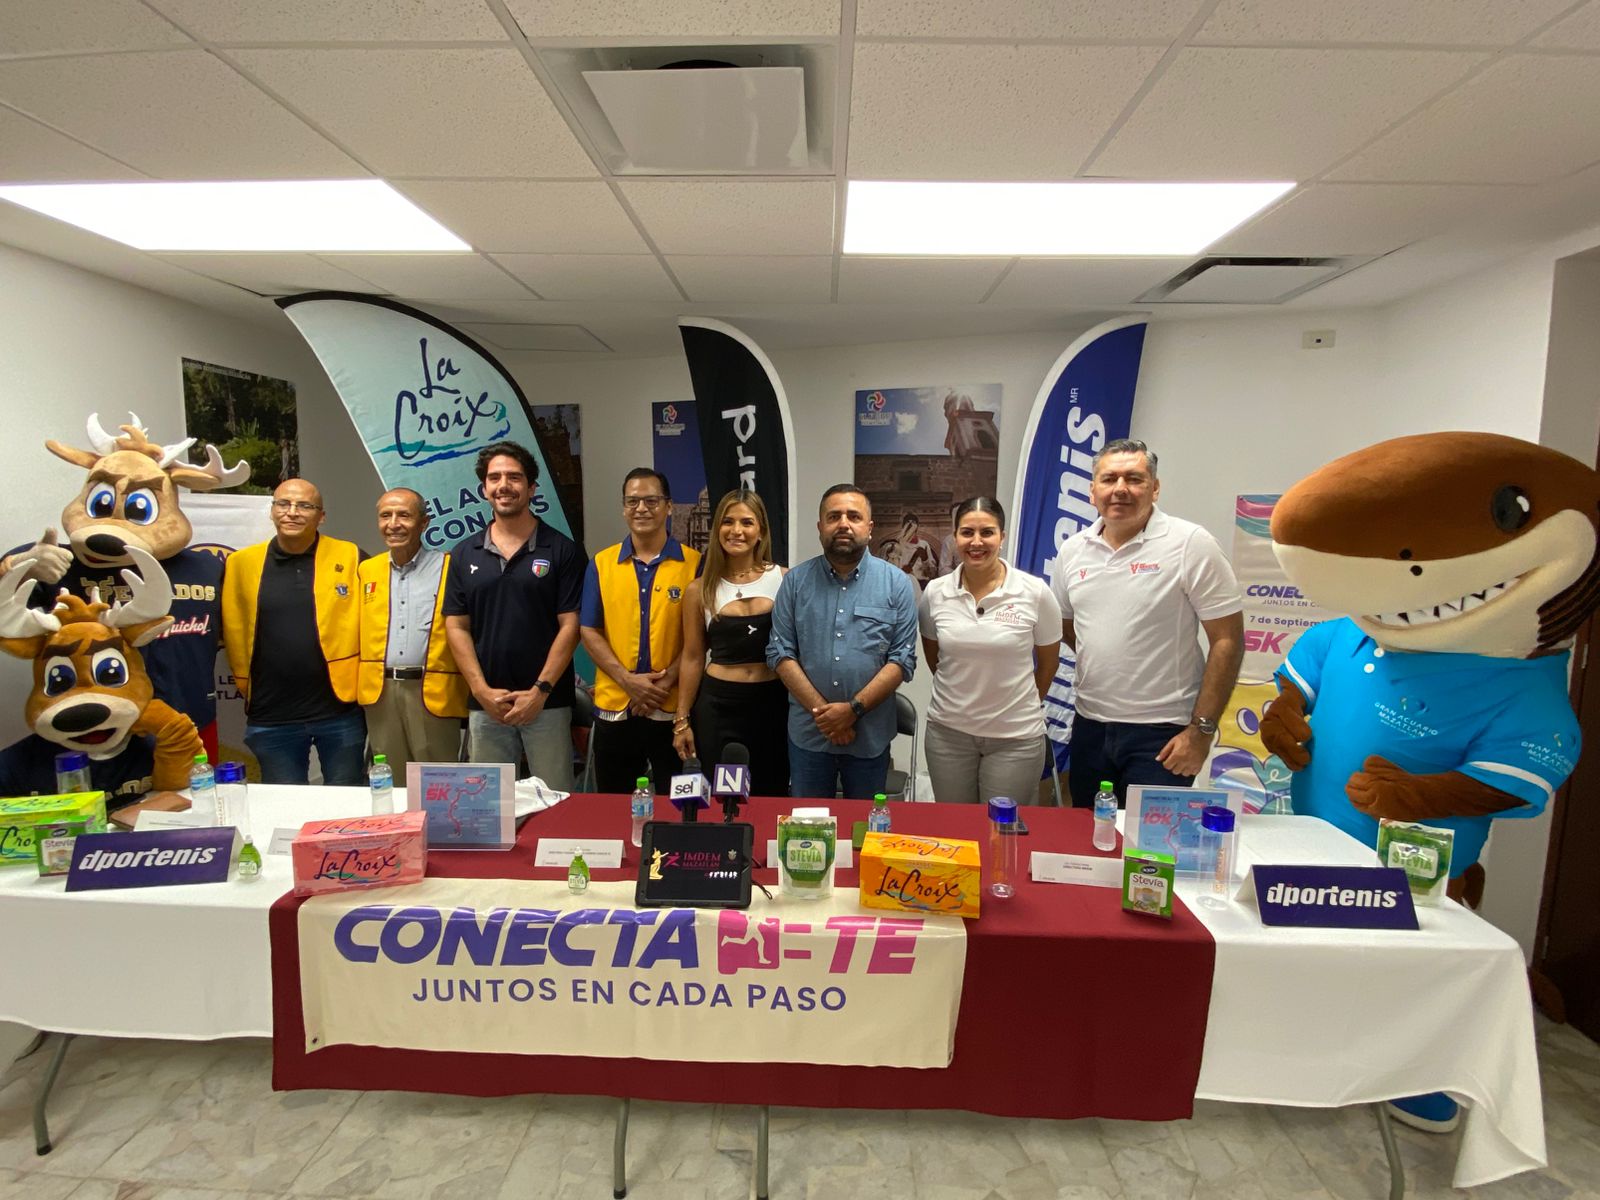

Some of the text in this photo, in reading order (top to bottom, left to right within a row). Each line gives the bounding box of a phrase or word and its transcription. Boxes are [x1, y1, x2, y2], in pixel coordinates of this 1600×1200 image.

[419, 338, 460, 398] La
[1069, 388, 1080, 403] MR
[395, 390, 498, 459] Croix
[721, 405, 756, 492] ard
[425, 511, 487, 547] CON
[1258, 616, 1271, 624] de
[1374, 701, 1397, 717] GRAN
[1397, 714, 1439, 736] ACUARIO
[1520, 741, 1551, 753] GRAN
[675, 781, 693, 794] sel
[79, 847, 217, 871] dportenis
[683, 852, 721, 861] IMDEM
[790, 849, 822, 862] STEVIA
[1266, 883, 1398, 907] dportenis
[334, 905, 699, 969] CONECTA
[412, 978, 847, 1012] JUNTOS EN CADA PASO
